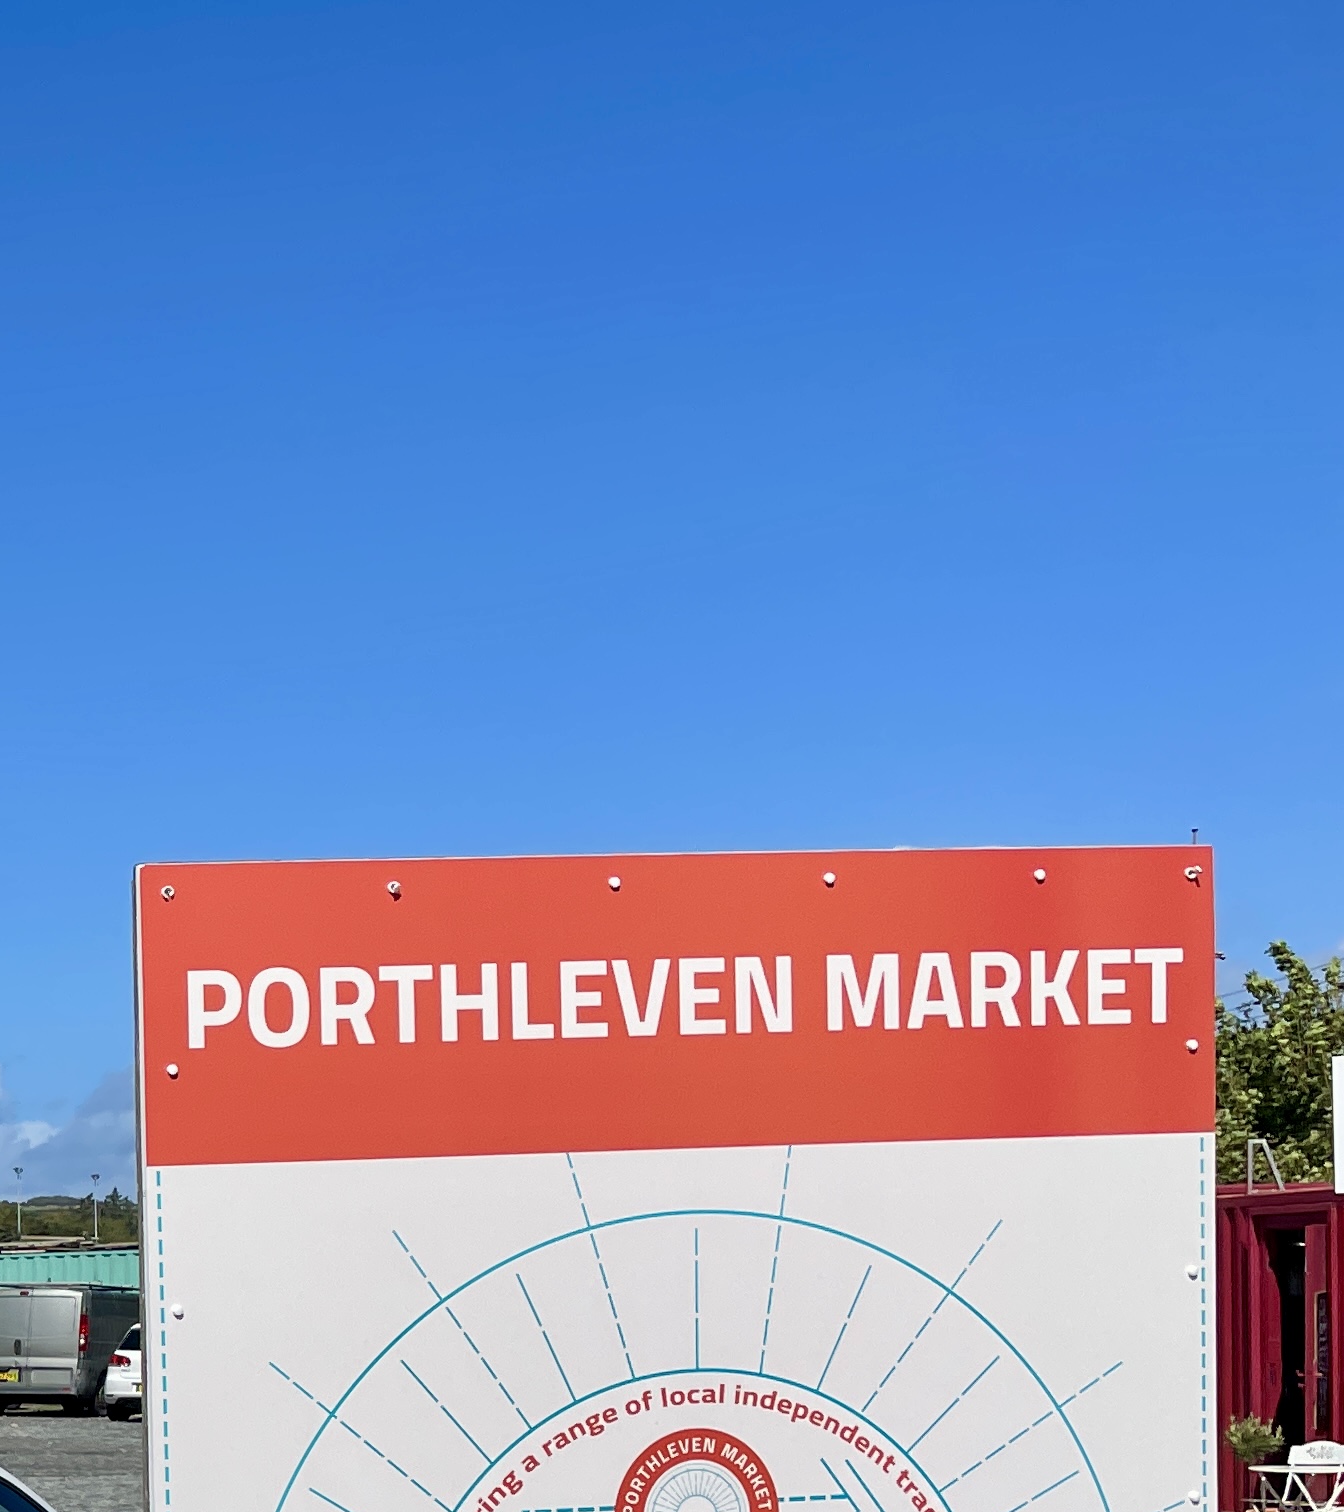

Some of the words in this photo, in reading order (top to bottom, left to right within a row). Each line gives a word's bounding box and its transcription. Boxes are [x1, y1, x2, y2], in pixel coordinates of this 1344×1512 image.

[185, 953, 793, 1050] PORTHLEVEN
[826, 945, 1184, 1032] MARKET
[521, 1455, 541, 1473] a
[542, 1407, 619, 1457] range
[624, 1390, 653, 1416] of
[660, 1384, 725, 1408] local
[734, 1384, 896, 1473] independent
[720, 1442, 773, 1511] MARKET
